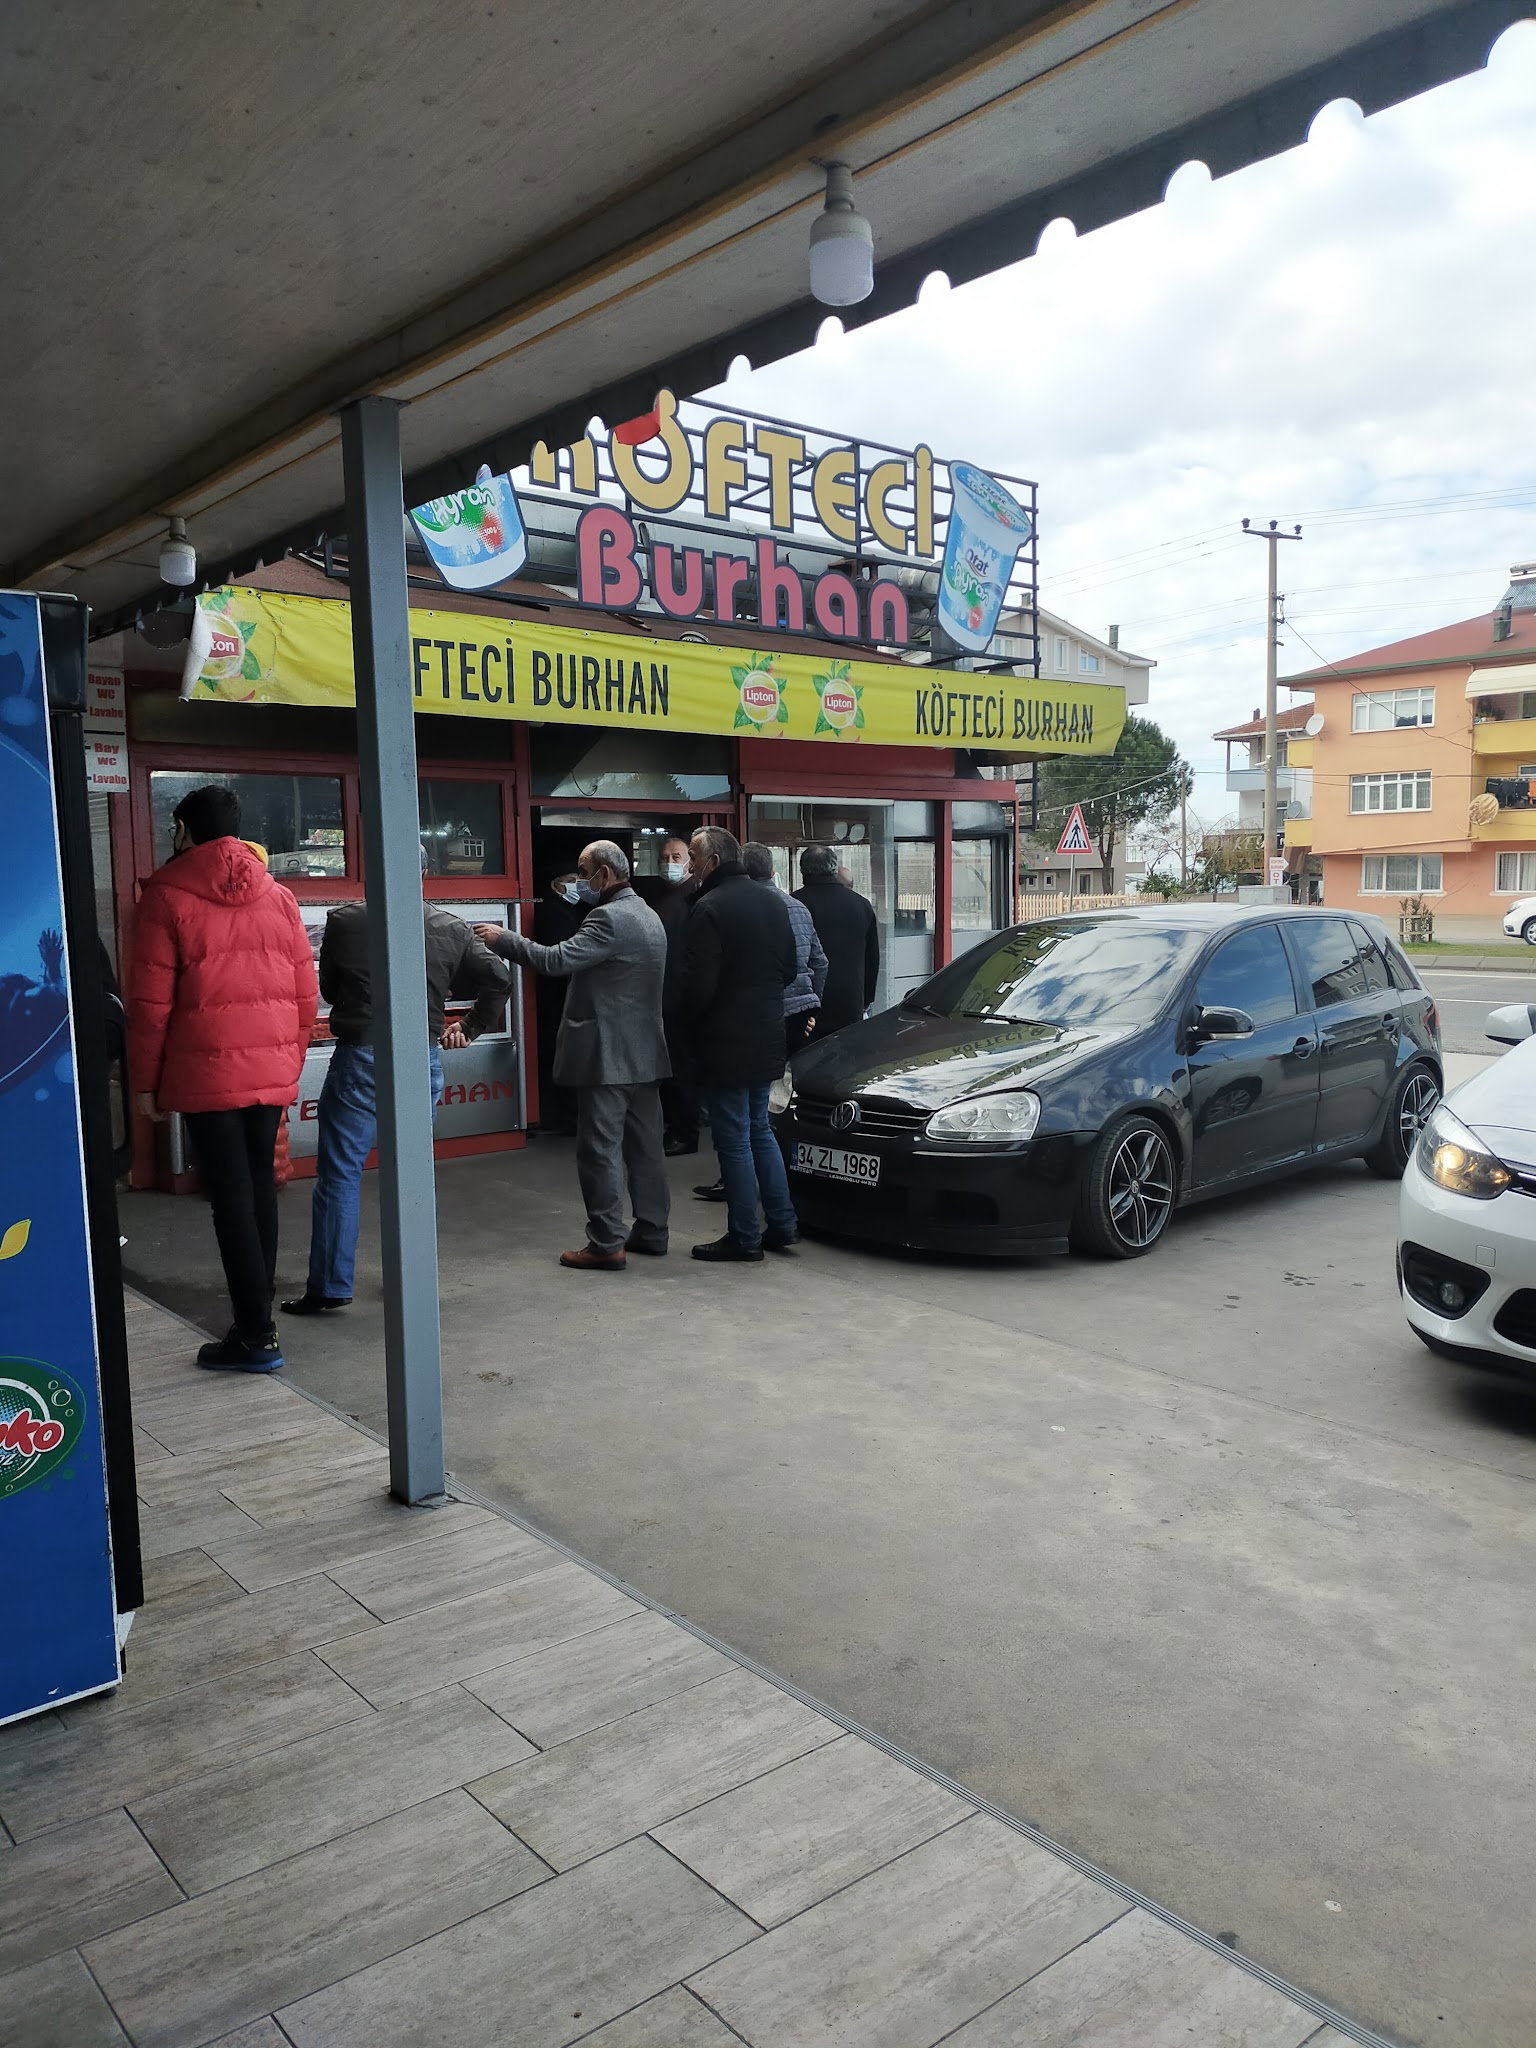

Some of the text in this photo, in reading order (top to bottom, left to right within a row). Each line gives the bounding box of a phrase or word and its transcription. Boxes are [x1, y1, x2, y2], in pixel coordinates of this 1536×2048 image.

[576, 503, 911, 646] Burhan
[953, 564, 990, 606] Ayran
[211, 640, 235, 653] ton
[88, 673, 121, 686] Bayan
[413, 638, 669, 717] FTECİ BURHAN
[97, 688, 116, 699] WC
[746, 690, 774, 703] Lipton
[827, 697, 852, 709] Lipton
[89, 706, 124, 718] Lavabo
[916, 682, 1094, 744] KÖFTECİ BURHAN
[94, 742, 119, 755] Bay
[97, 757, 117, 766] WC
[93, 773, 127, 785] Lavabo
[437, 1079, 514, 1106] HAN
[798, 1145, 879, 1179] 34 ZL 1968
